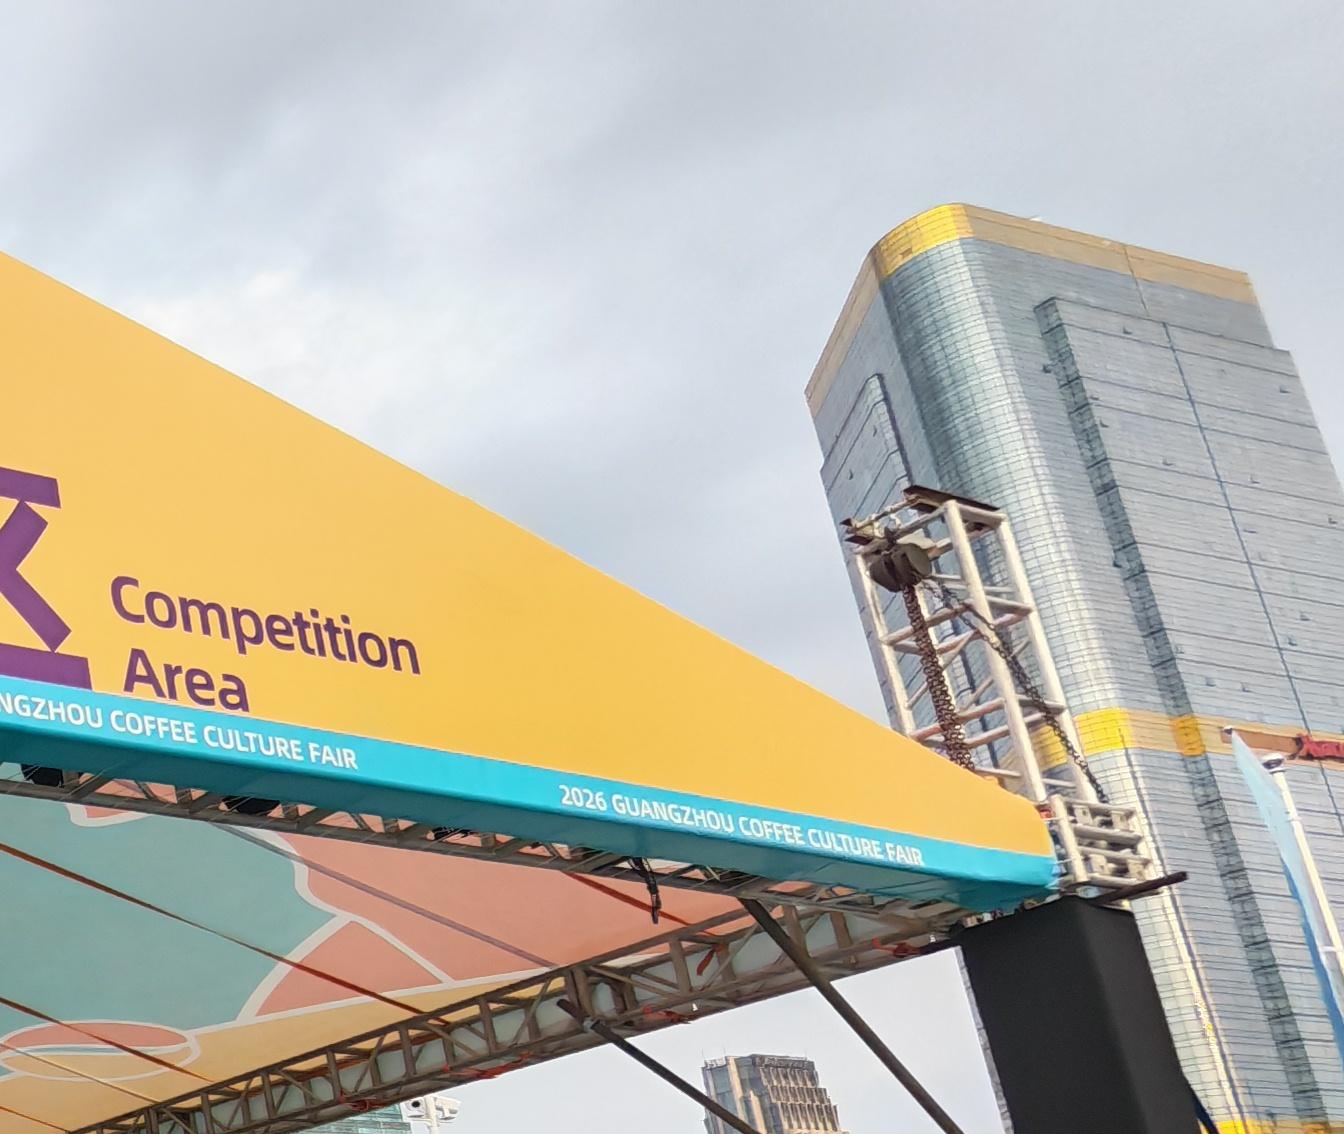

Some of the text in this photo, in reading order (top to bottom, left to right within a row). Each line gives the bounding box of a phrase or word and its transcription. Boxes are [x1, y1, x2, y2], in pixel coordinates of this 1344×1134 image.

[110, 575, 422, 675] Competition
[123, 647, 251, 712] Area
[110, 709, 199, 745] COFFEE
[203, 724, 305, 762] CULTURE
[308, 740, 359, 770] FAIR
[558, 783, 924, 867] 2026 GUANGZHOU COFFEE CULTURE FAIR
